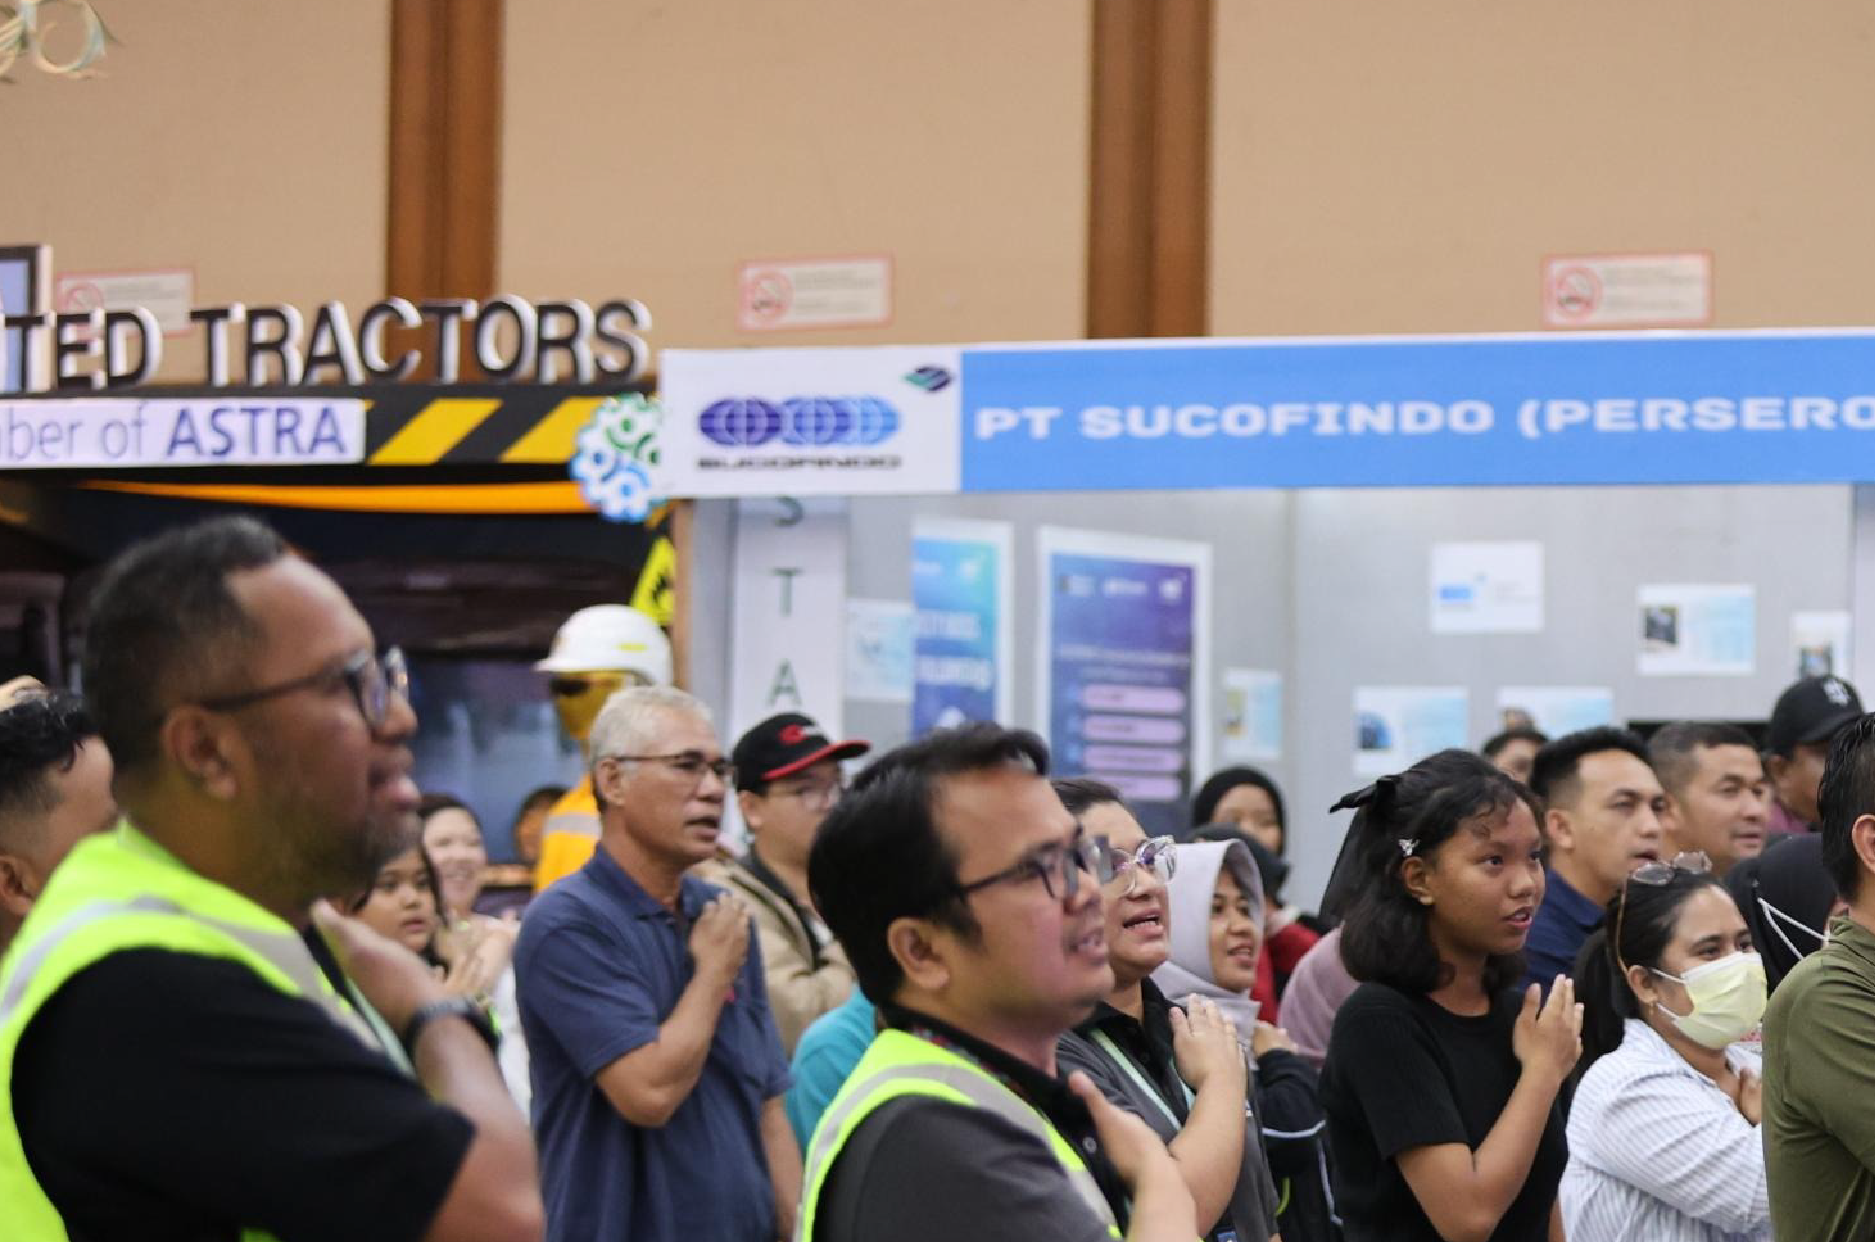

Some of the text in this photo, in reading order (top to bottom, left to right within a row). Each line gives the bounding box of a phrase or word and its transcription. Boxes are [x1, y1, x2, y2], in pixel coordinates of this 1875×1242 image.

[3, 296, 652, 391] TED TRACTORS
[100, 402, 147, 459] of
[165, 406, 347, 457] ASTRA
[975, 406, 1061, 441] PT
[1080, 399, 1495, 439] SUCOFINDO
